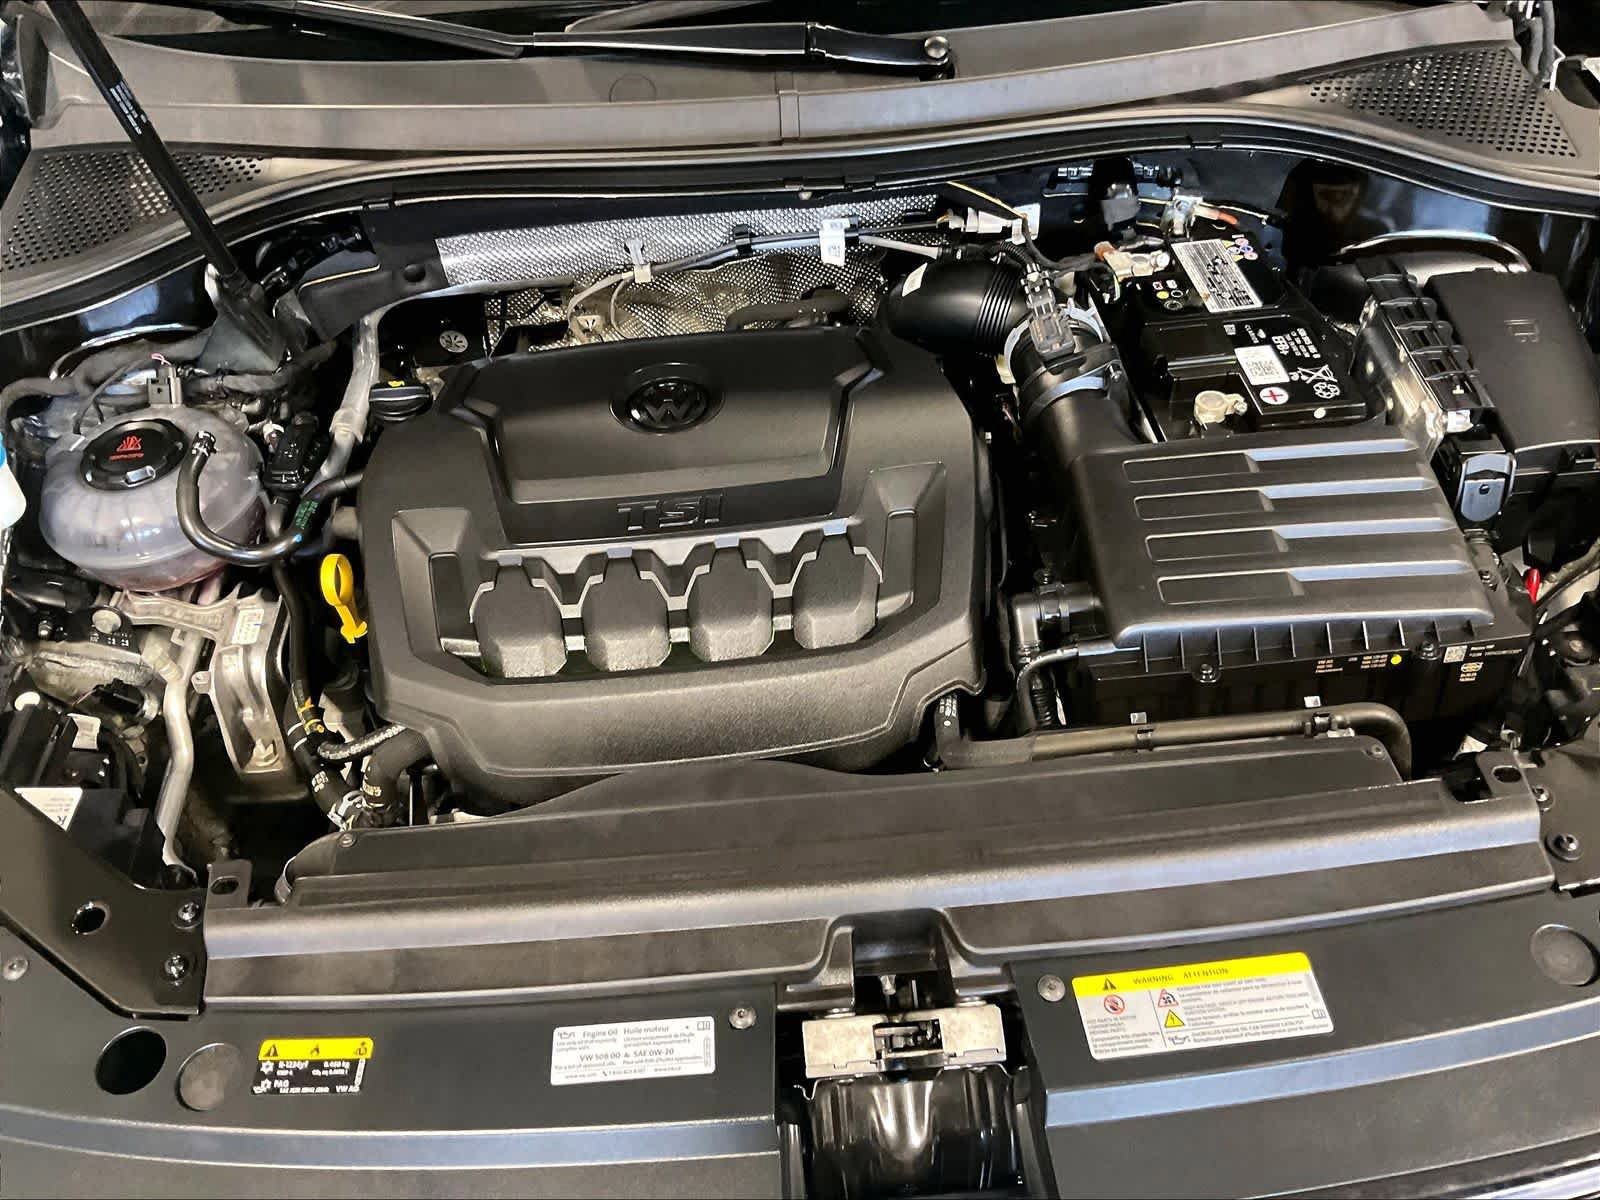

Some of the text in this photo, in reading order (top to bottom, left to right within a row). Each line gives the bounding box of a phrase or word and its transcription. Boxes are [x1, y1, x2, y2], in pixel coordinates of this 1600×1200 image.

[616, 491, 723, 535] TSI
[1133, 967, 1230, 985] WARNING ATTENTION
[583, 1030, 606, 1039] Engine
[624, 1024, 670, 1035] Huile moteur
[580, 1053, 594, 1062] VW
